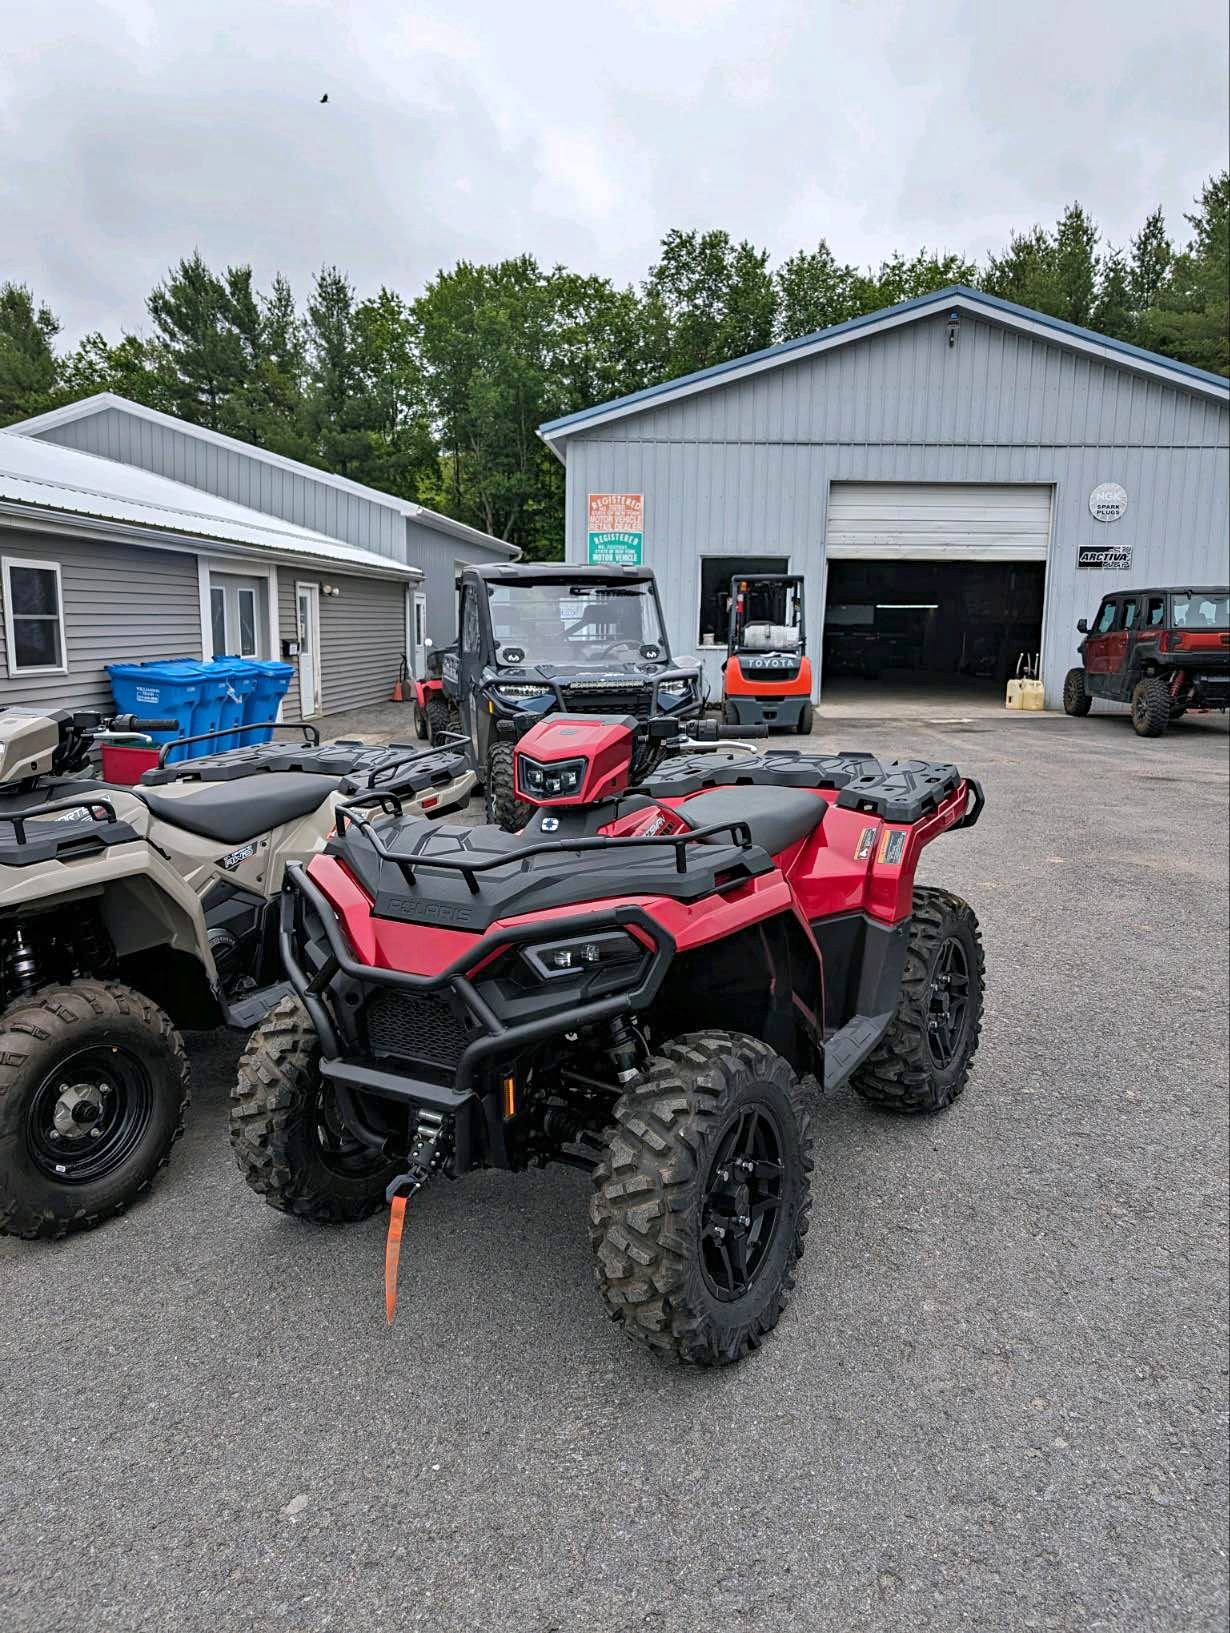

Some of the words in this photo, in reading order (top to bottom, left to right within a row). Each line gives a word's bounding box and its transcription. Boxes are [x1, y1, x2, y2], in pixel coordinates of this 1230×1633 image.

[1096, 491, 1121, 500] NGK
[591, 495, 641, 510] REGISTERED
[590, 515, 611, 523] MOTOR
[615, 515, 641, 523] VEHICLE
[593, 533, 639, 545] REGISTERED
[592, 553, 613, 561] MOTOR
[615, 553, 638, 561] VEHICLE
[1080, 552, 1127, 561] ARCTIVA
[749, 659, 794, 667] TOYOTA
[386, 898, 473, 921] POLARIS
